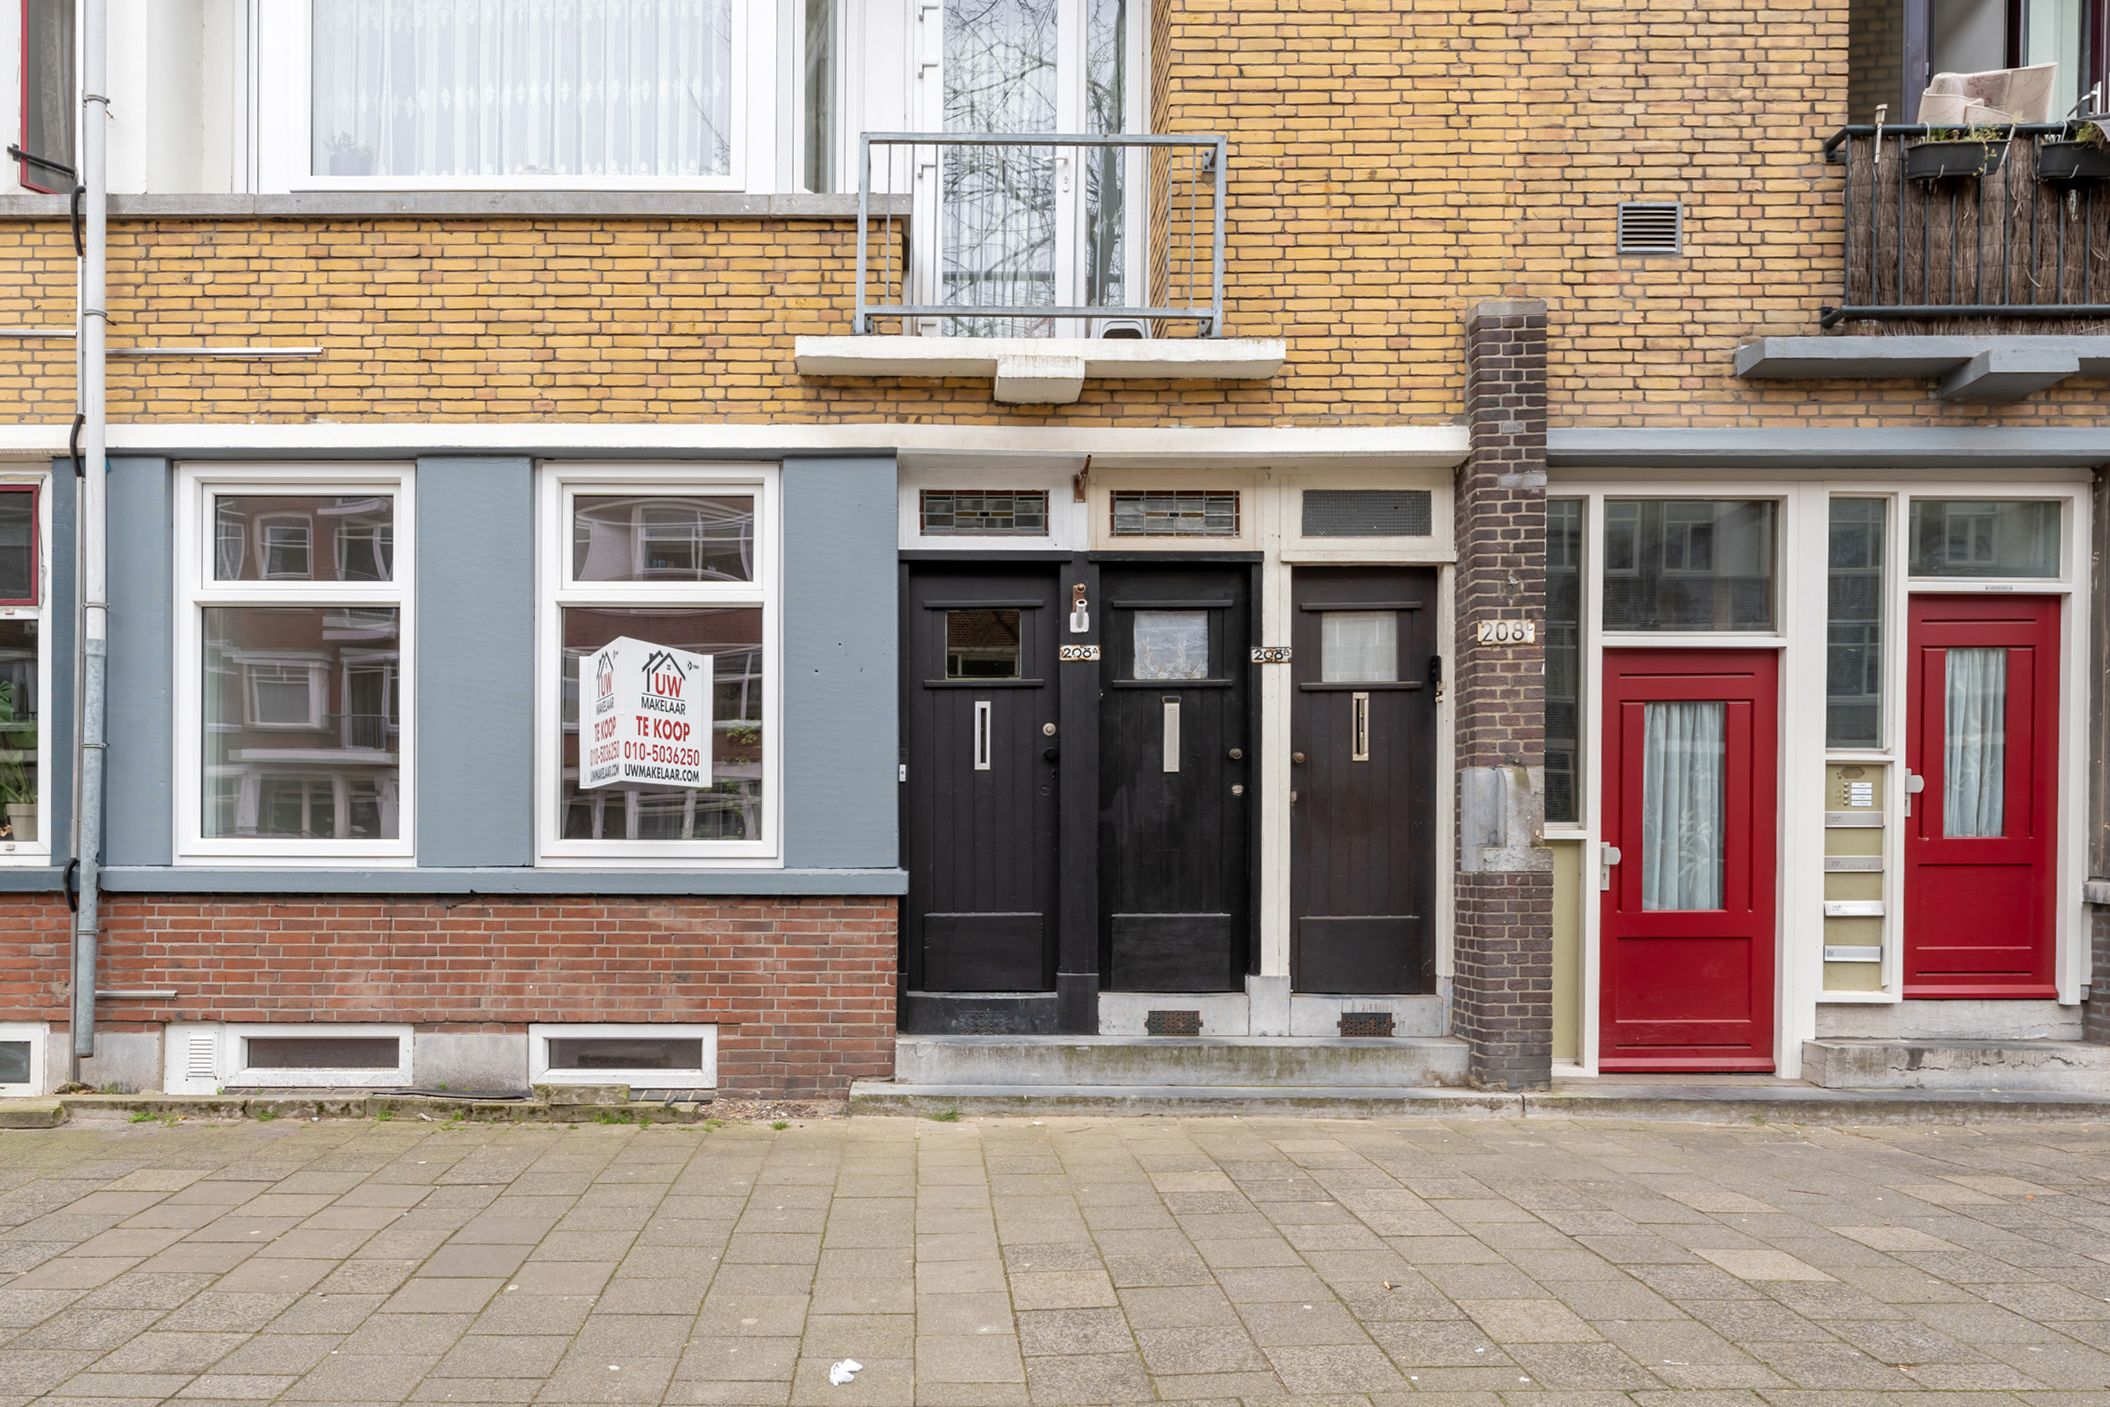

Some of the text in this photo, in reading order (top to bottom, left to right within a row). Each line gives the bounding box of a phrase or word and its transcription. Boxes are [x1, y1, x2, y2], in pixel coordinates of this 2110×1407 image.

[600, 671, 613, 697] UW
[655, 672, 683, 698] UW
[641, 696, 686, 716] MAKELAAR
[594, 715, 616, 743] TE KOOP
[636, 715, 691, 742] TE KOOP
[624, 740, 700, 767] 010-5036250
[624, 763, 700, 783] UWMAKELAAR.COM
